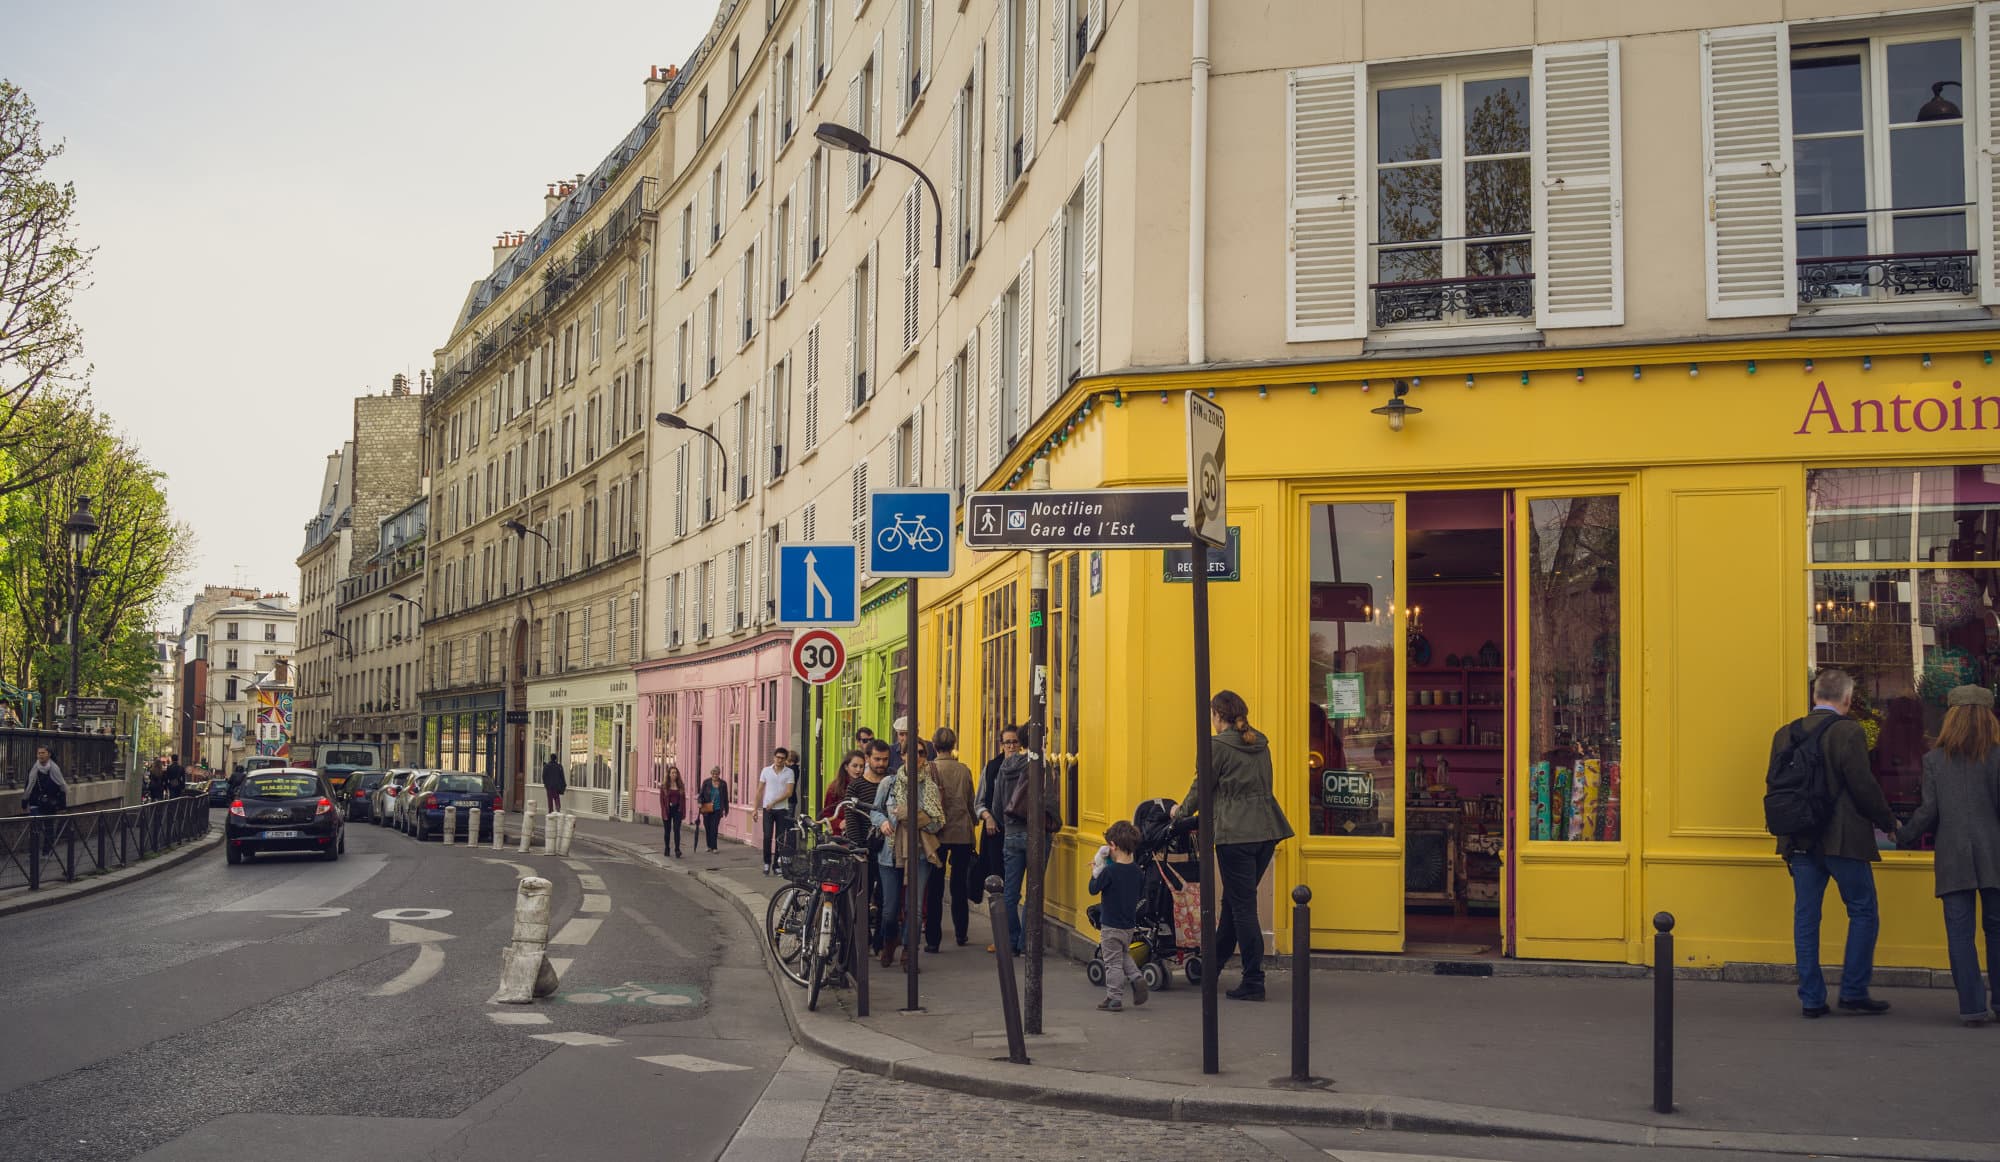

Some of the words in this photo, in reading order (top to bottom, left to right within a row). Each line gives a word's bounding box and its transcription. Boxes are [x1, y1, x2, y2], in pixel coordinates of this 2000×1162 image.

[1193, 400, 1203, 418] FIN
[1208, 408, 1223, 430] ZONE
[1793, 380, 2000, 435] Antoin
[1204, 470, 1217, 502] 30
[1031, 501, 1103, 516] Noctilien
[1030, 523, 1066, 536] Gare
[1073, 522, 1091, 536] de
[1098, 521, 1136, 536] l'Est
[803, 644, 835, 669] 30
[1325, 775, 1370, 794] OPEN
[1326, 795, 1369, 805] WELCOME
